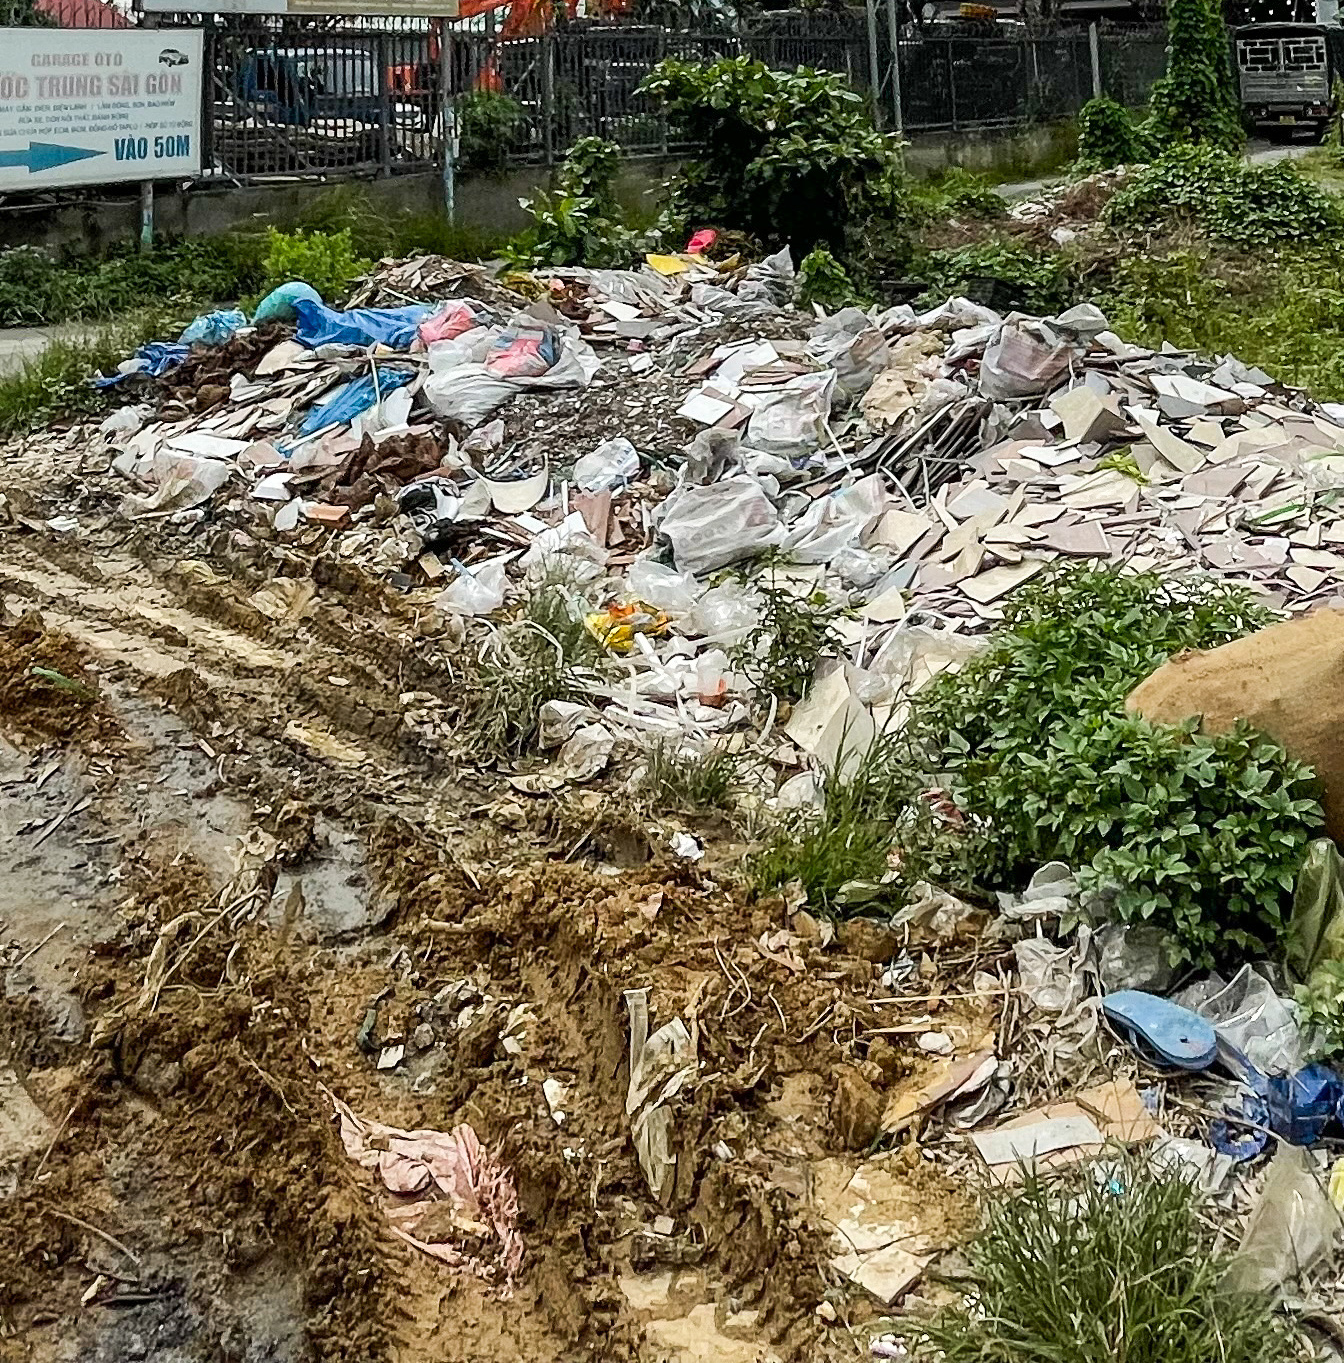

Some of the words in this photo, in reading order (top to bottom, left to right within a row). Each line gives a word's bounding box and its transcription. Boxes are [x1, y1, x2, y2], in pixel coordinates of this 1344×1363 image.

[31, 53, 89, 67] GARAGE
[35, 74, 102, 98] TRUNG
[114, 134, 148, 161] VÀO
[154, 135, 190, 158] 50M
